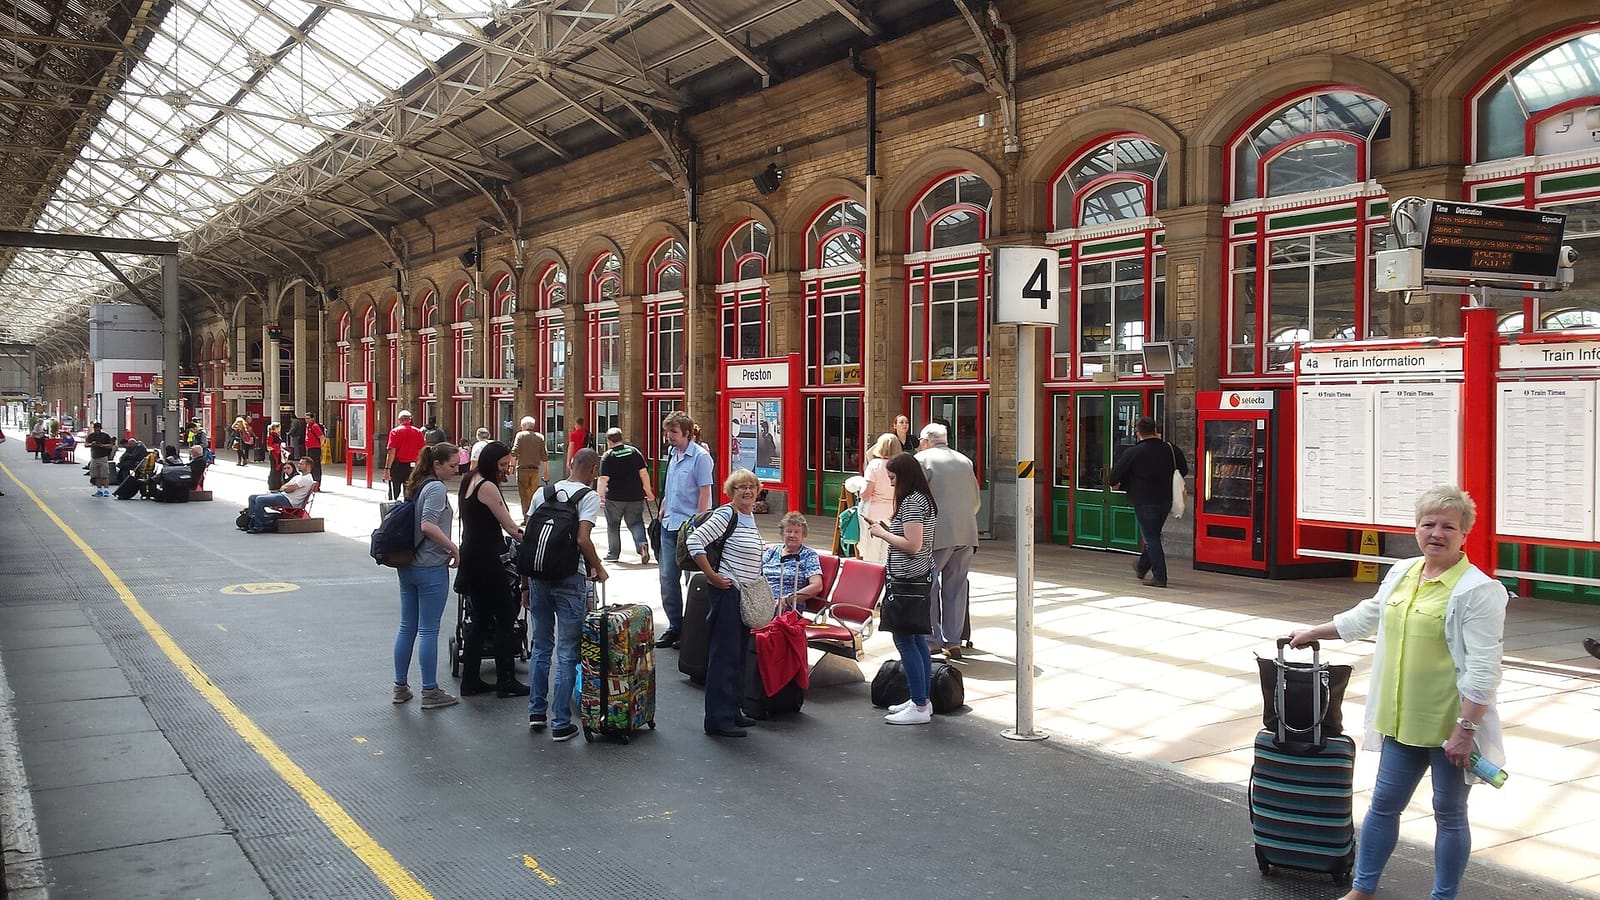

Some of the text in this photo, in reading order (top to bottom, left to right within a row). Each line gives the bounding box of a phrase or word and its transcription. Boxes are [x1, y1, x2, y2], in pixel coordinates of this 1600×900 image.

[1436, 204, 1563, 224] Time Destination Expected
[1022, 257, 1051, 310] 4
[1306, 355, 1425, 369] 4a Train Information
[1541, 349, 1574, 362] Train
[742, 367, 772, 381] Preston
[1241, 396, 1265, 404] selecta
